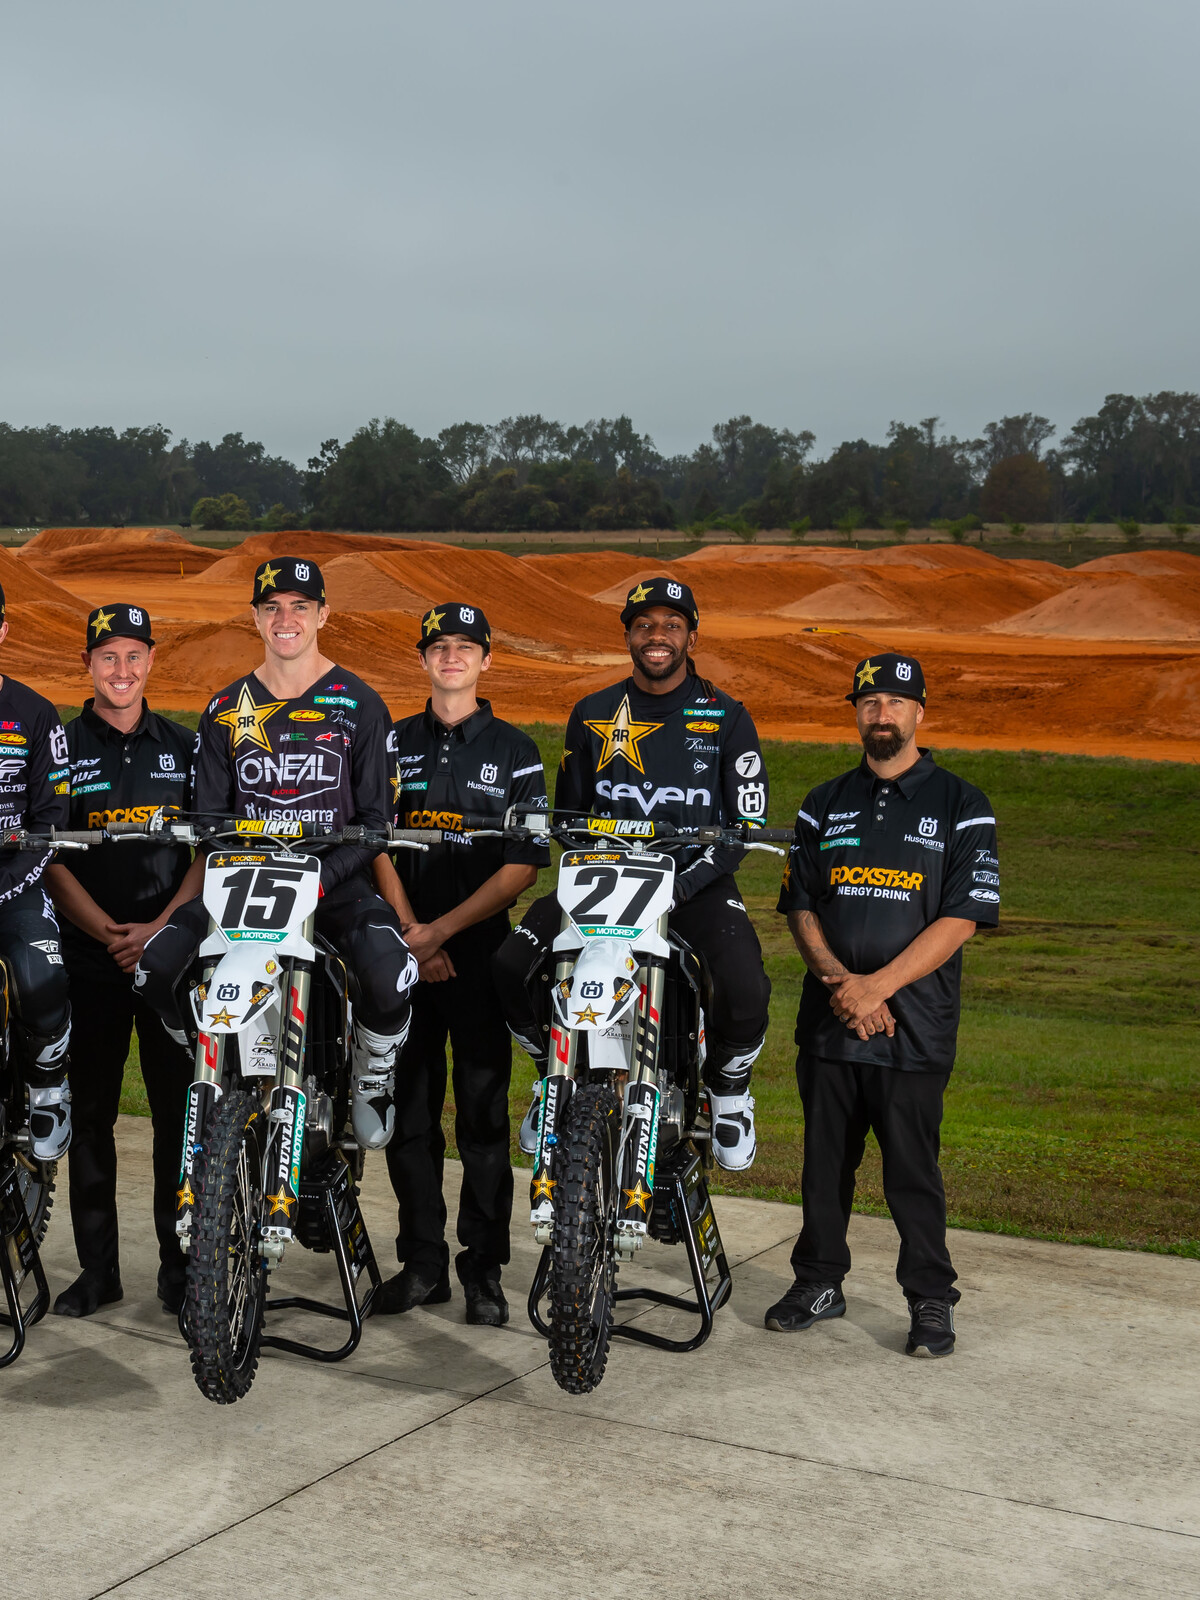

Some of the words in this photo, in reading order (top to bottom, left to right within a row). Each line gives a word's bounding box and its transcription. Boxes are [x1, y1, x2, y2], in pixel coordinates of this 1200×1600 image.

[209, 696, 230, 714] WP
[326, 697, 356, 708] MOTOREX
[289, 710, 326, 721] FMF
[693, 709, 724, 717] MOTOREX
[685, 721, 720, 733] FMF
[684, 737, 720, 751] PARADISE
[75, 758, 101, 768] FLY
[150, 771, 187, 780] Husqvarna
[78, 782, 109, 794] MOTOREX
[466, 780, 505, 795] Husqvarna
[832, 811, 861, 820] FLY
[825, 823, 857, 837] WP
[443, 831, 473, 845] DRINK
[829, 838, 858, 847] MOTOREX
[904, 834, 945, 849] Husqvarna
[830, 867, 924, 890] ROCKSTAR
[220, 868, 304, 930] 15
[569, 866, 665, 927] 27
[837, 886, 871, 897] NERGY
[873, 888, 911, 901] DRINK
[241, 931, 281, 940] MOTOREX
[596, 927, 635, 937] MOTOREX
[185, 1091, 199, 1175] DUNLOP
[292, 1102, 306, 1163] MOTOREX
[650, 1098, 660, 1163] MOTOREX
